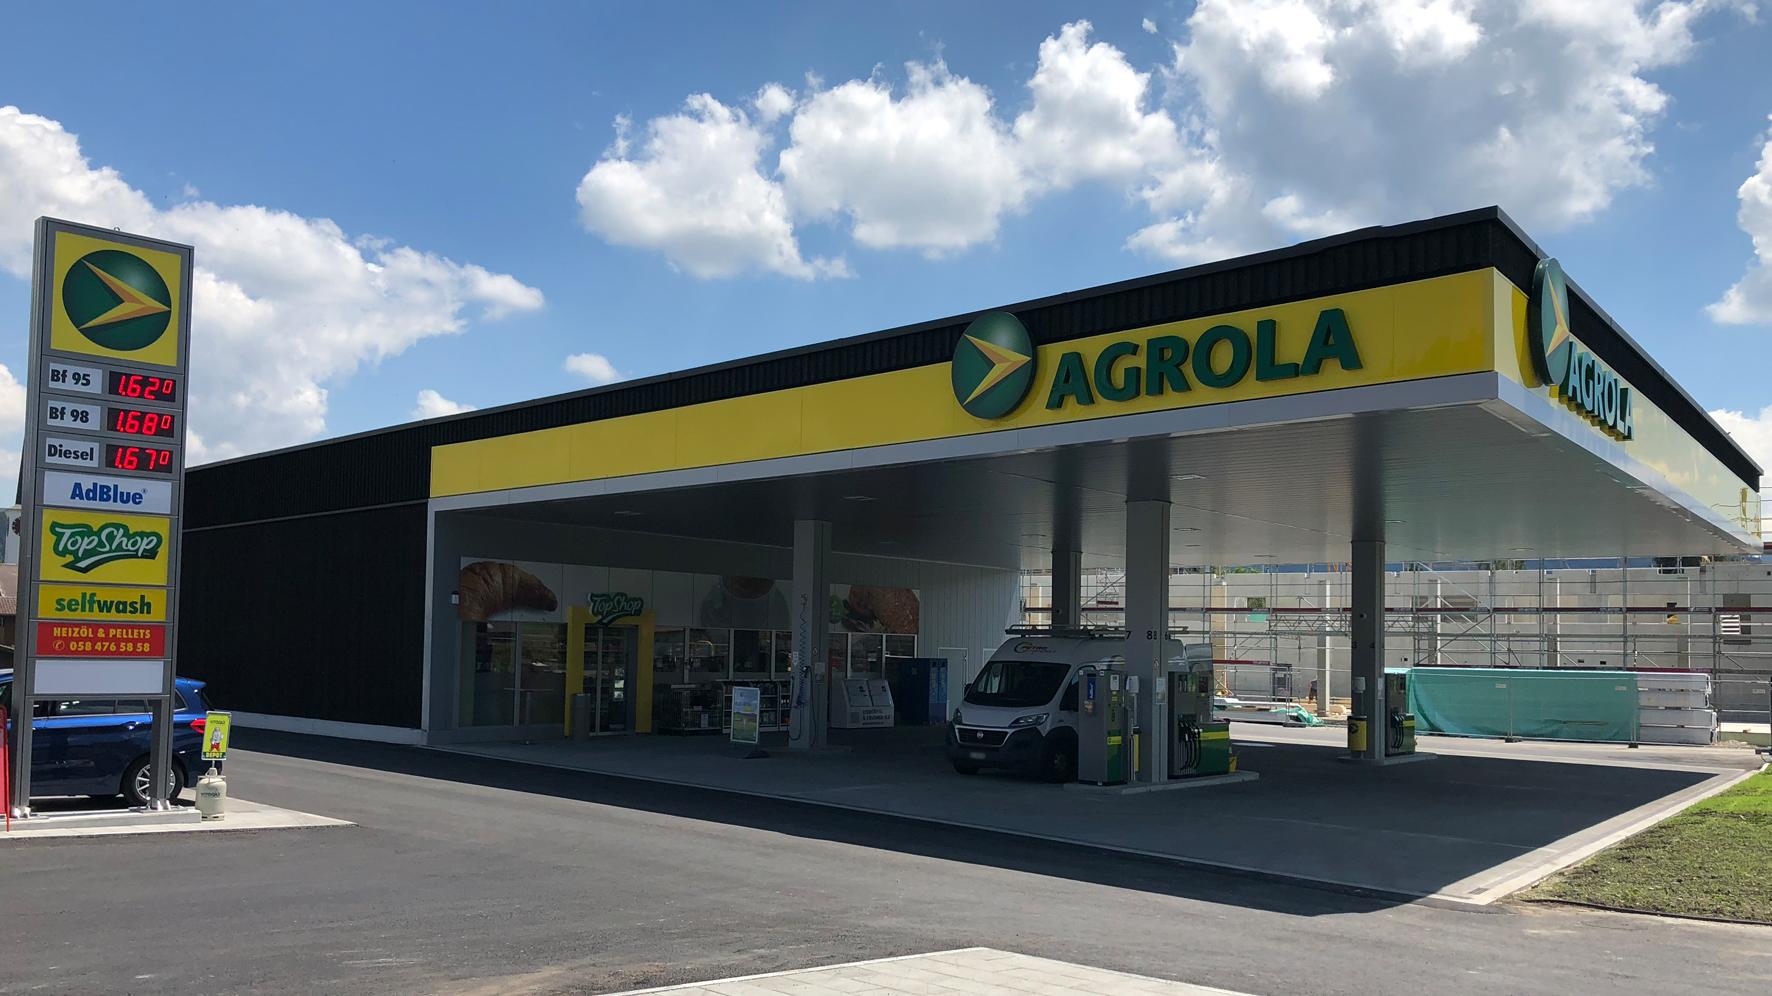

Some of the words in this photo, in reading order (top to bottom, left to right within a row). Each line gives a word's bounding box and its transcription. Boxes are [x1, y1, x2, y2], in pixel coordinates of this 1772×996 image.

[1045, 308, 1363, 409] AGROLA
[50, 368, 67, 383] Bf
[72, 372, 91, 386] 95
[1566, 341, 1635, 441] AGROLA
[49, 406, 66, 421] Bf
[70, 410, 89, 423] 98
[47, 444, 94, 461] Diesel
[53, 525, 159, 558] TopShop
[54, 592, 152, 615] selfwash
[591, 595, 642, 615] TopShop
[53, 626, 93, 637] HEIZÖL
[97, 628, 105, 637] &
[109, 629, 151, 639] PELLETS
[70, 641, 91, 651] 058
[95, 642, 116, 651] 476
[120, 642, 133, 652] 58
[136, 643, 150, 652] 58
